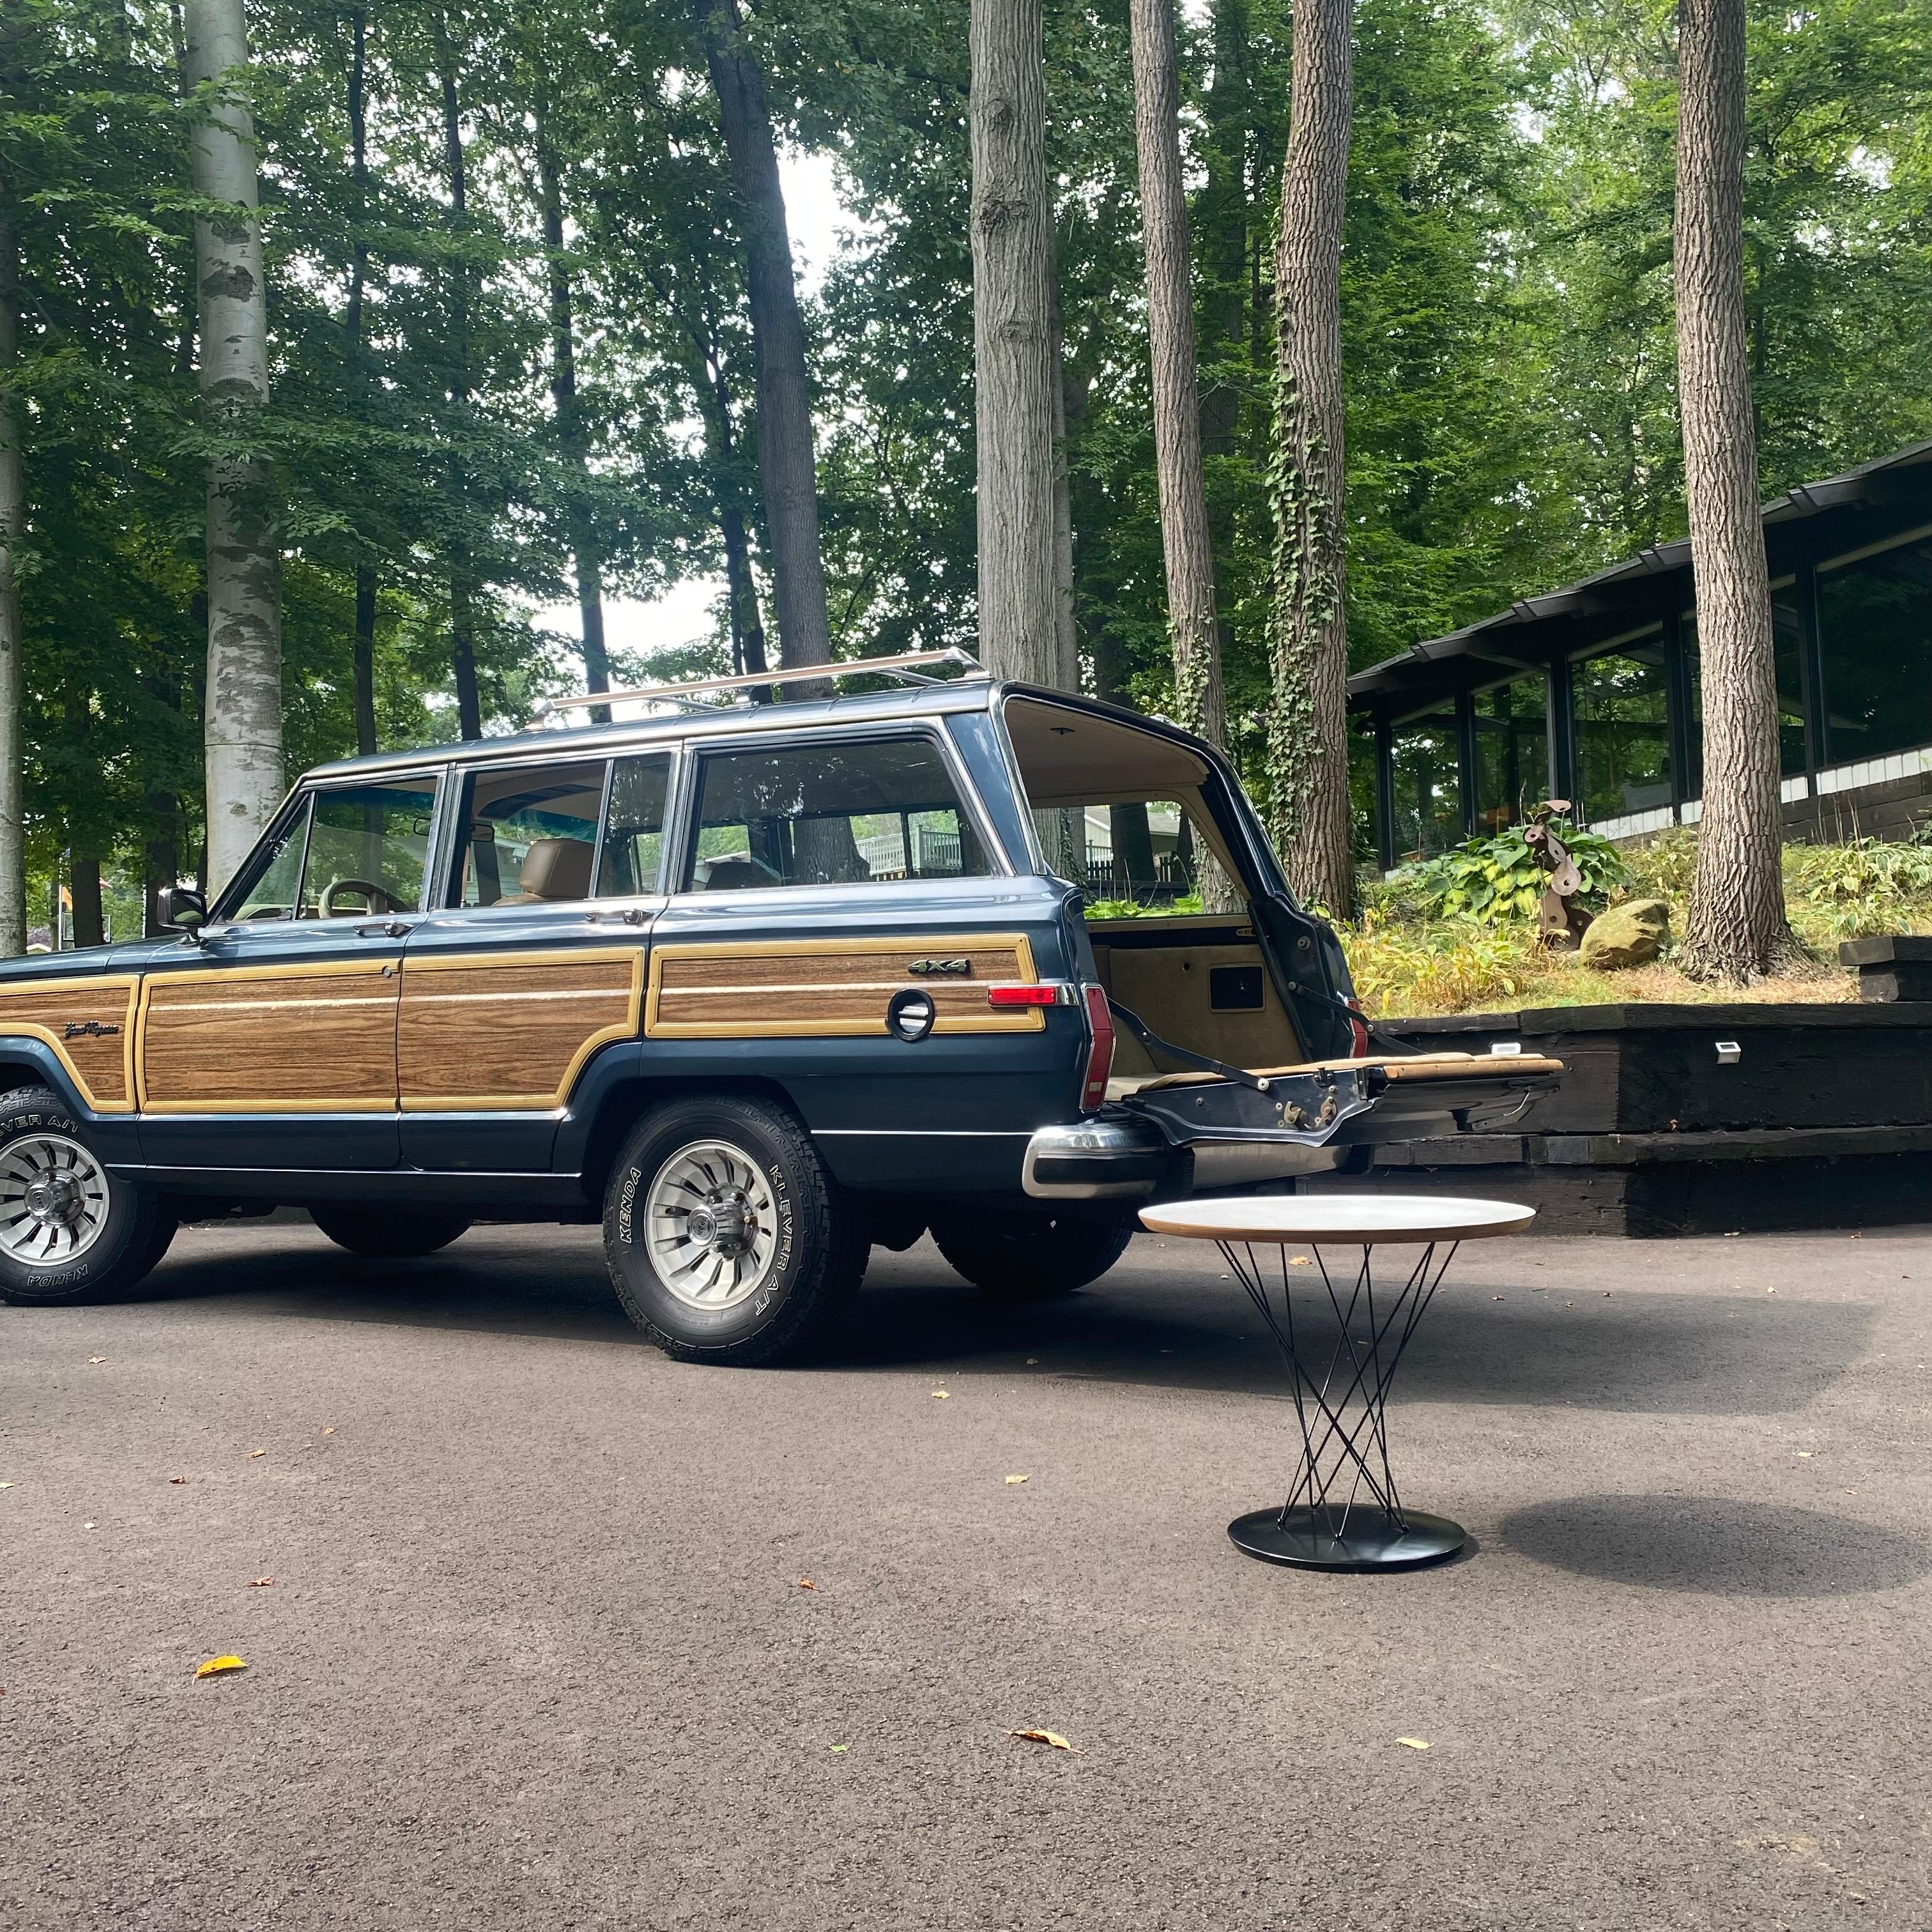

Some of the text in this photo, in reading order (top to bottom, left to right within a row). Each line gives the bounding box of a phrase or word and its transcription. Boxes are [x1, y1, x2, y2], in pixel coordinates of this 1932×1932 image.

[47, 1116, 79, 1133] A/T
[620, 1167, 641, 1243] KENDA
[755, 1164, 792, 1316] KLEVER A/T
[27, 1264, 88, 1286] KENDA
